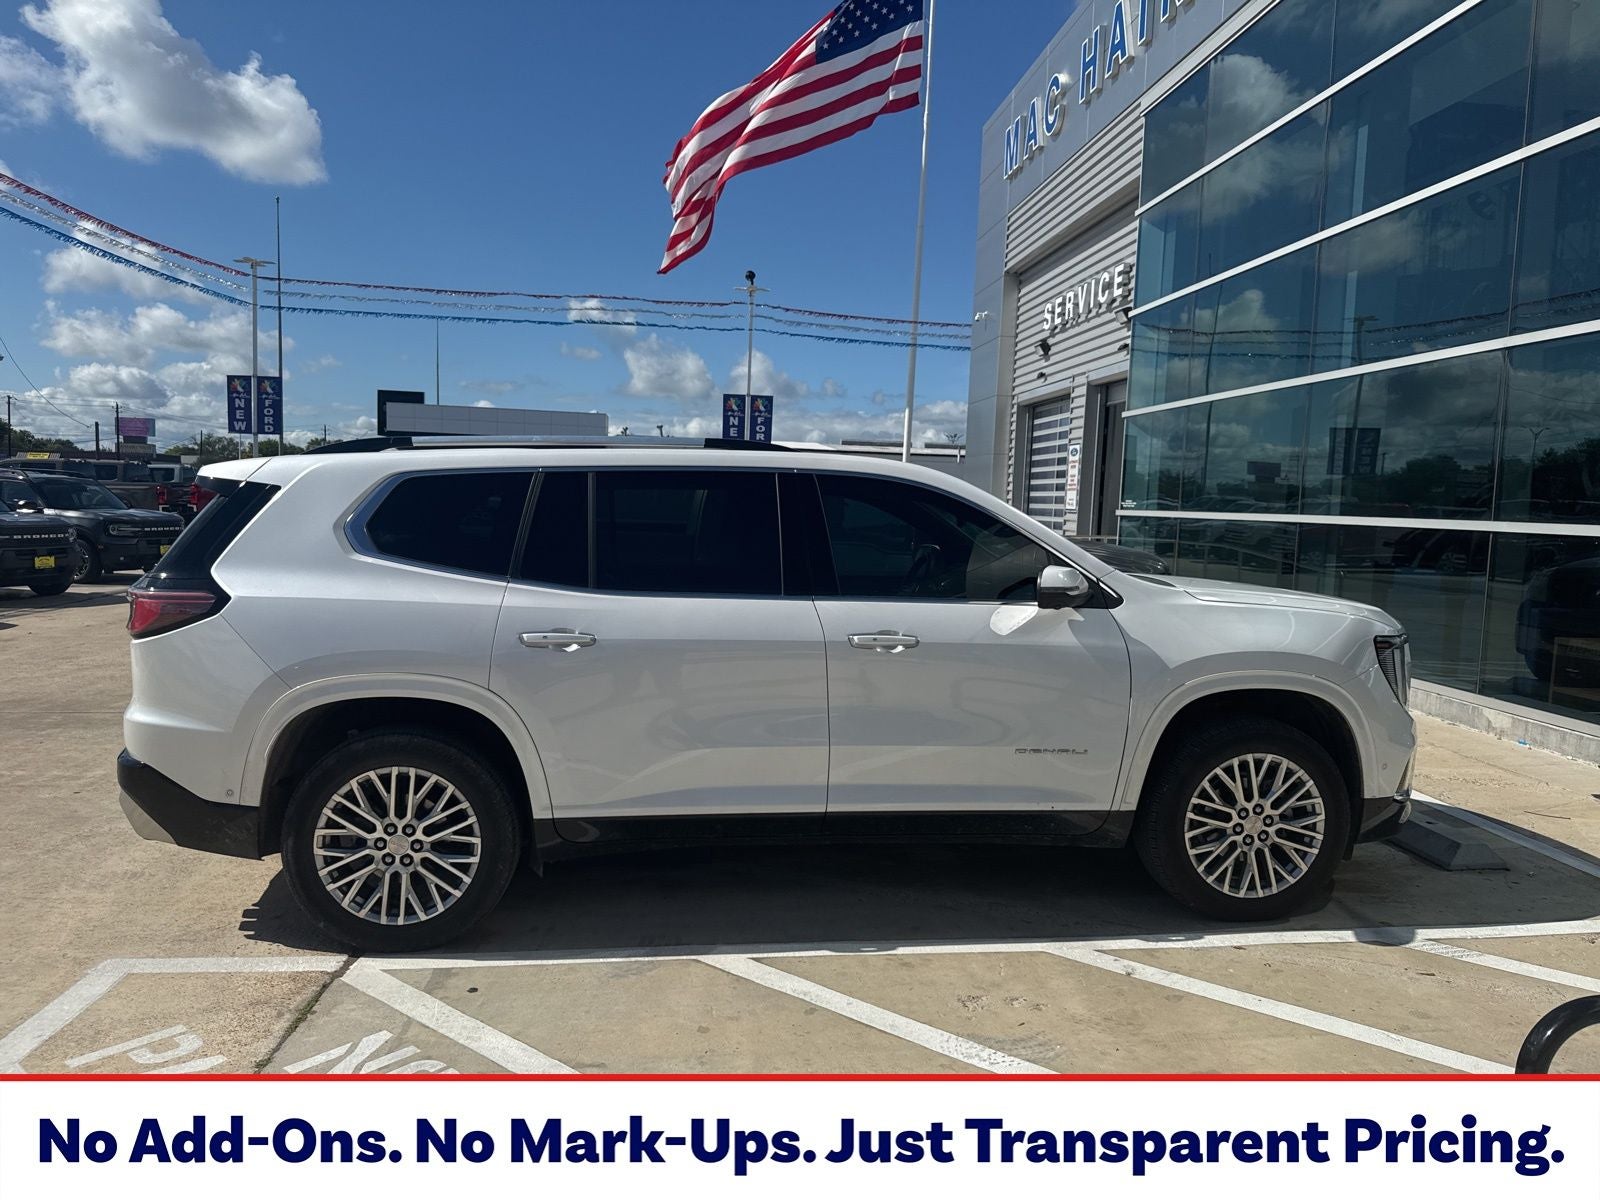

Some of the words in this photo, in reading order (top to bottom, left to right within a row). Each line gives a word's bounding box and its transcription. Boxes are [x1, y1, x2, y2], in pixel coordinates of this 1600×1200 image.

[1003, 73, 1065, 180] MAC
[1043, 263, 1125, 330] SERVICE
[233, 398, 247, 431] NEW
[263, 399, 274, 433] FORD
[729, 416, 739, 437] NE
[755, 417, 766, 441] FOR
